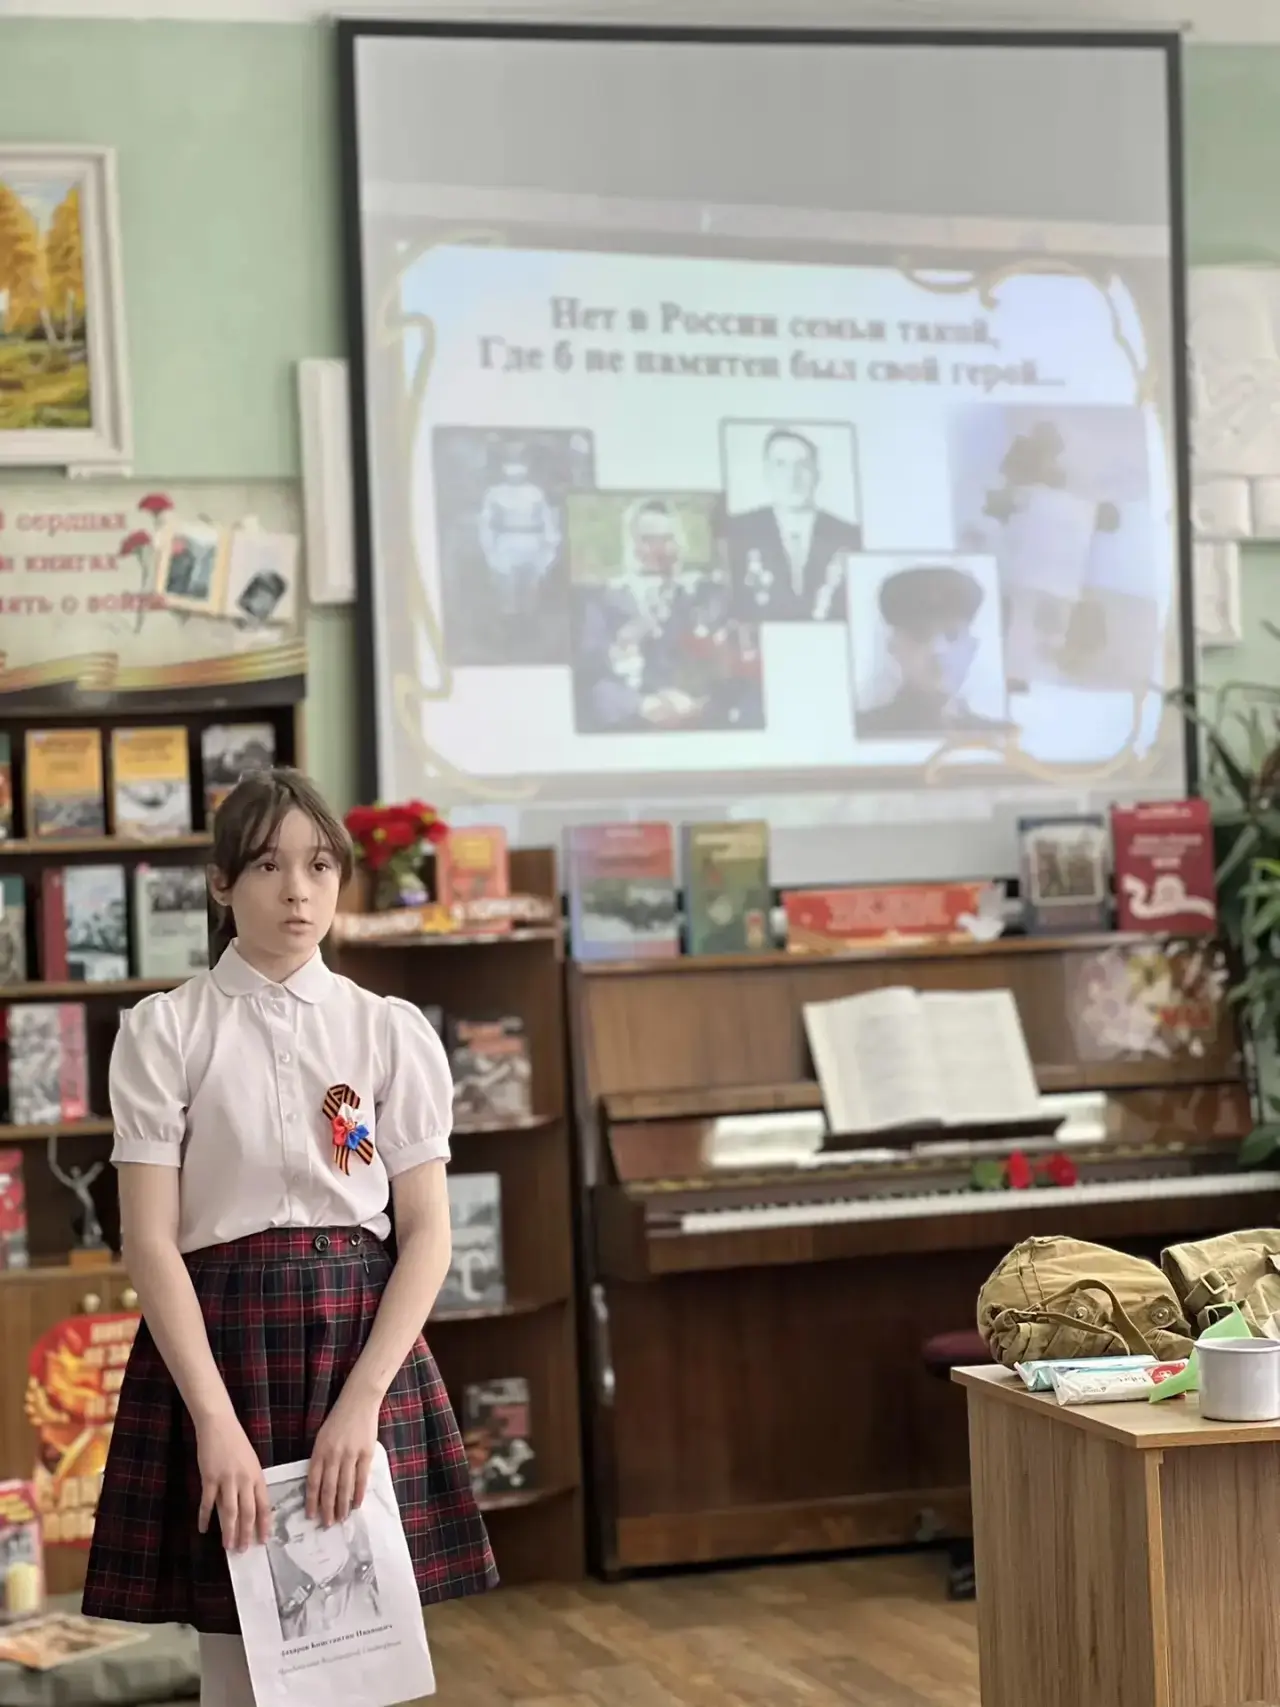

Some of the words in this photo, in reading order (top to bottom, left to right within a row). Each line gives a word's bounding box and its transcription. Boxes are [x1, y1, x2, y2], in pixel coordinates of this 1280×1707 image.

[549, 295, 618, 330] Нет
[628, 308, 650, 332] в
[660, 300, 777, 339] России
[789, 315, 886, 341] семьи
[897, 316, 1000, 350] такой,
[478, 335, 544, 373] Где
[553, 339, 575, 375] б
[585, 348, 626, 373] не
[634, 351, 780, 378] памятен
[789, 348, 857, 381] был
[867, 354, 940, 383] свой
[26, 555, 118, 572] книгах
[60, 595, 79, 613] о
